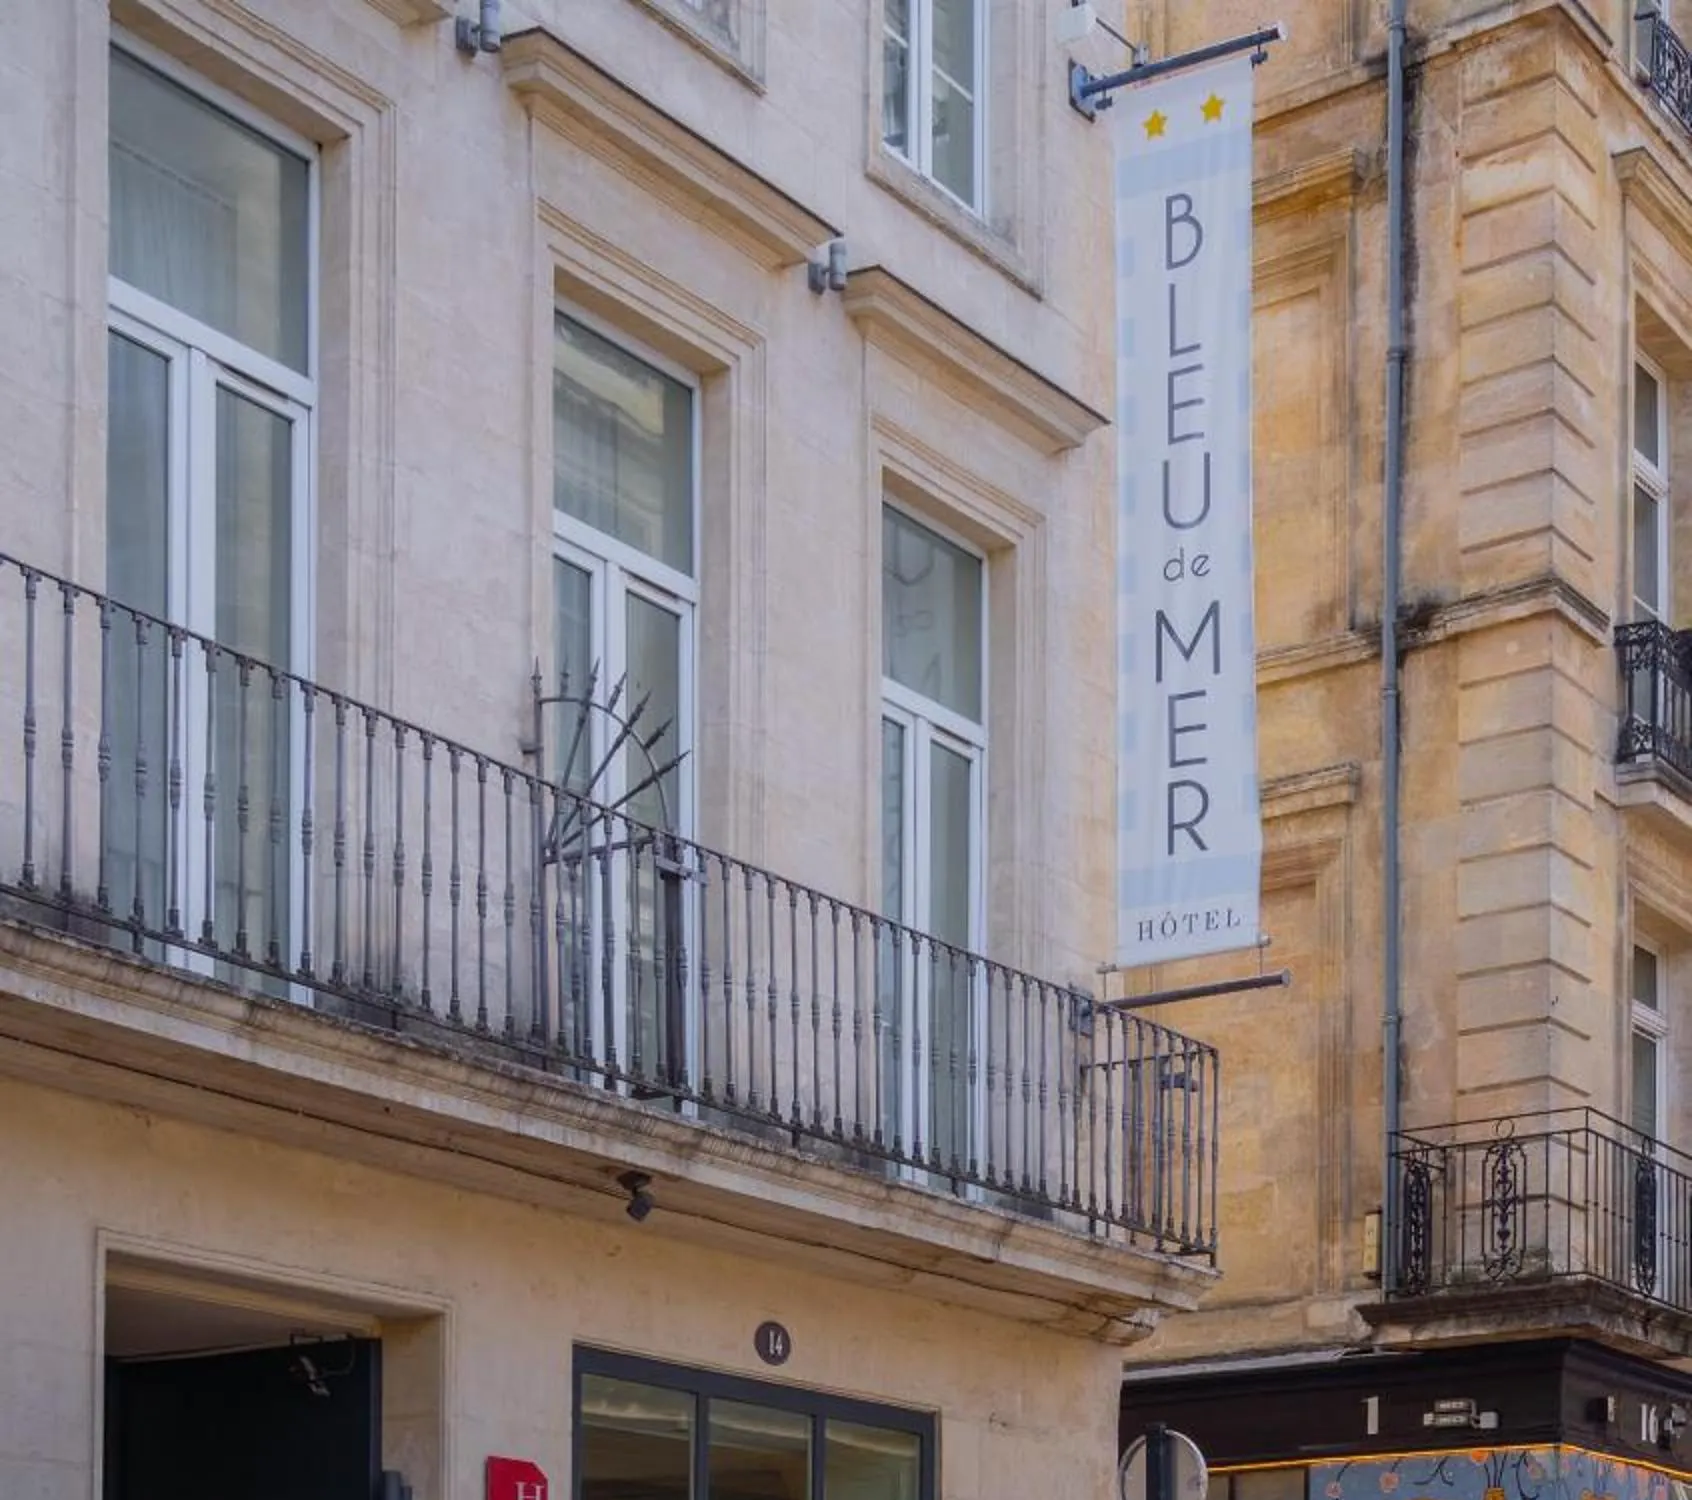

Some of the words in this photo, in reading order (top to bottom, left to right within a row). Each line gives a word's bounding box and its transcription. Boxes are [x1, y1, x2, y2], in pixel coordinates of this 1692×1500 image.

[1163, 192, 1211, 530] BLEU
[1162, 547, 1211, 582] de
[1155, 599, 1221, 856] MER
[1137, 907, 1241, 942] HÔTEL
